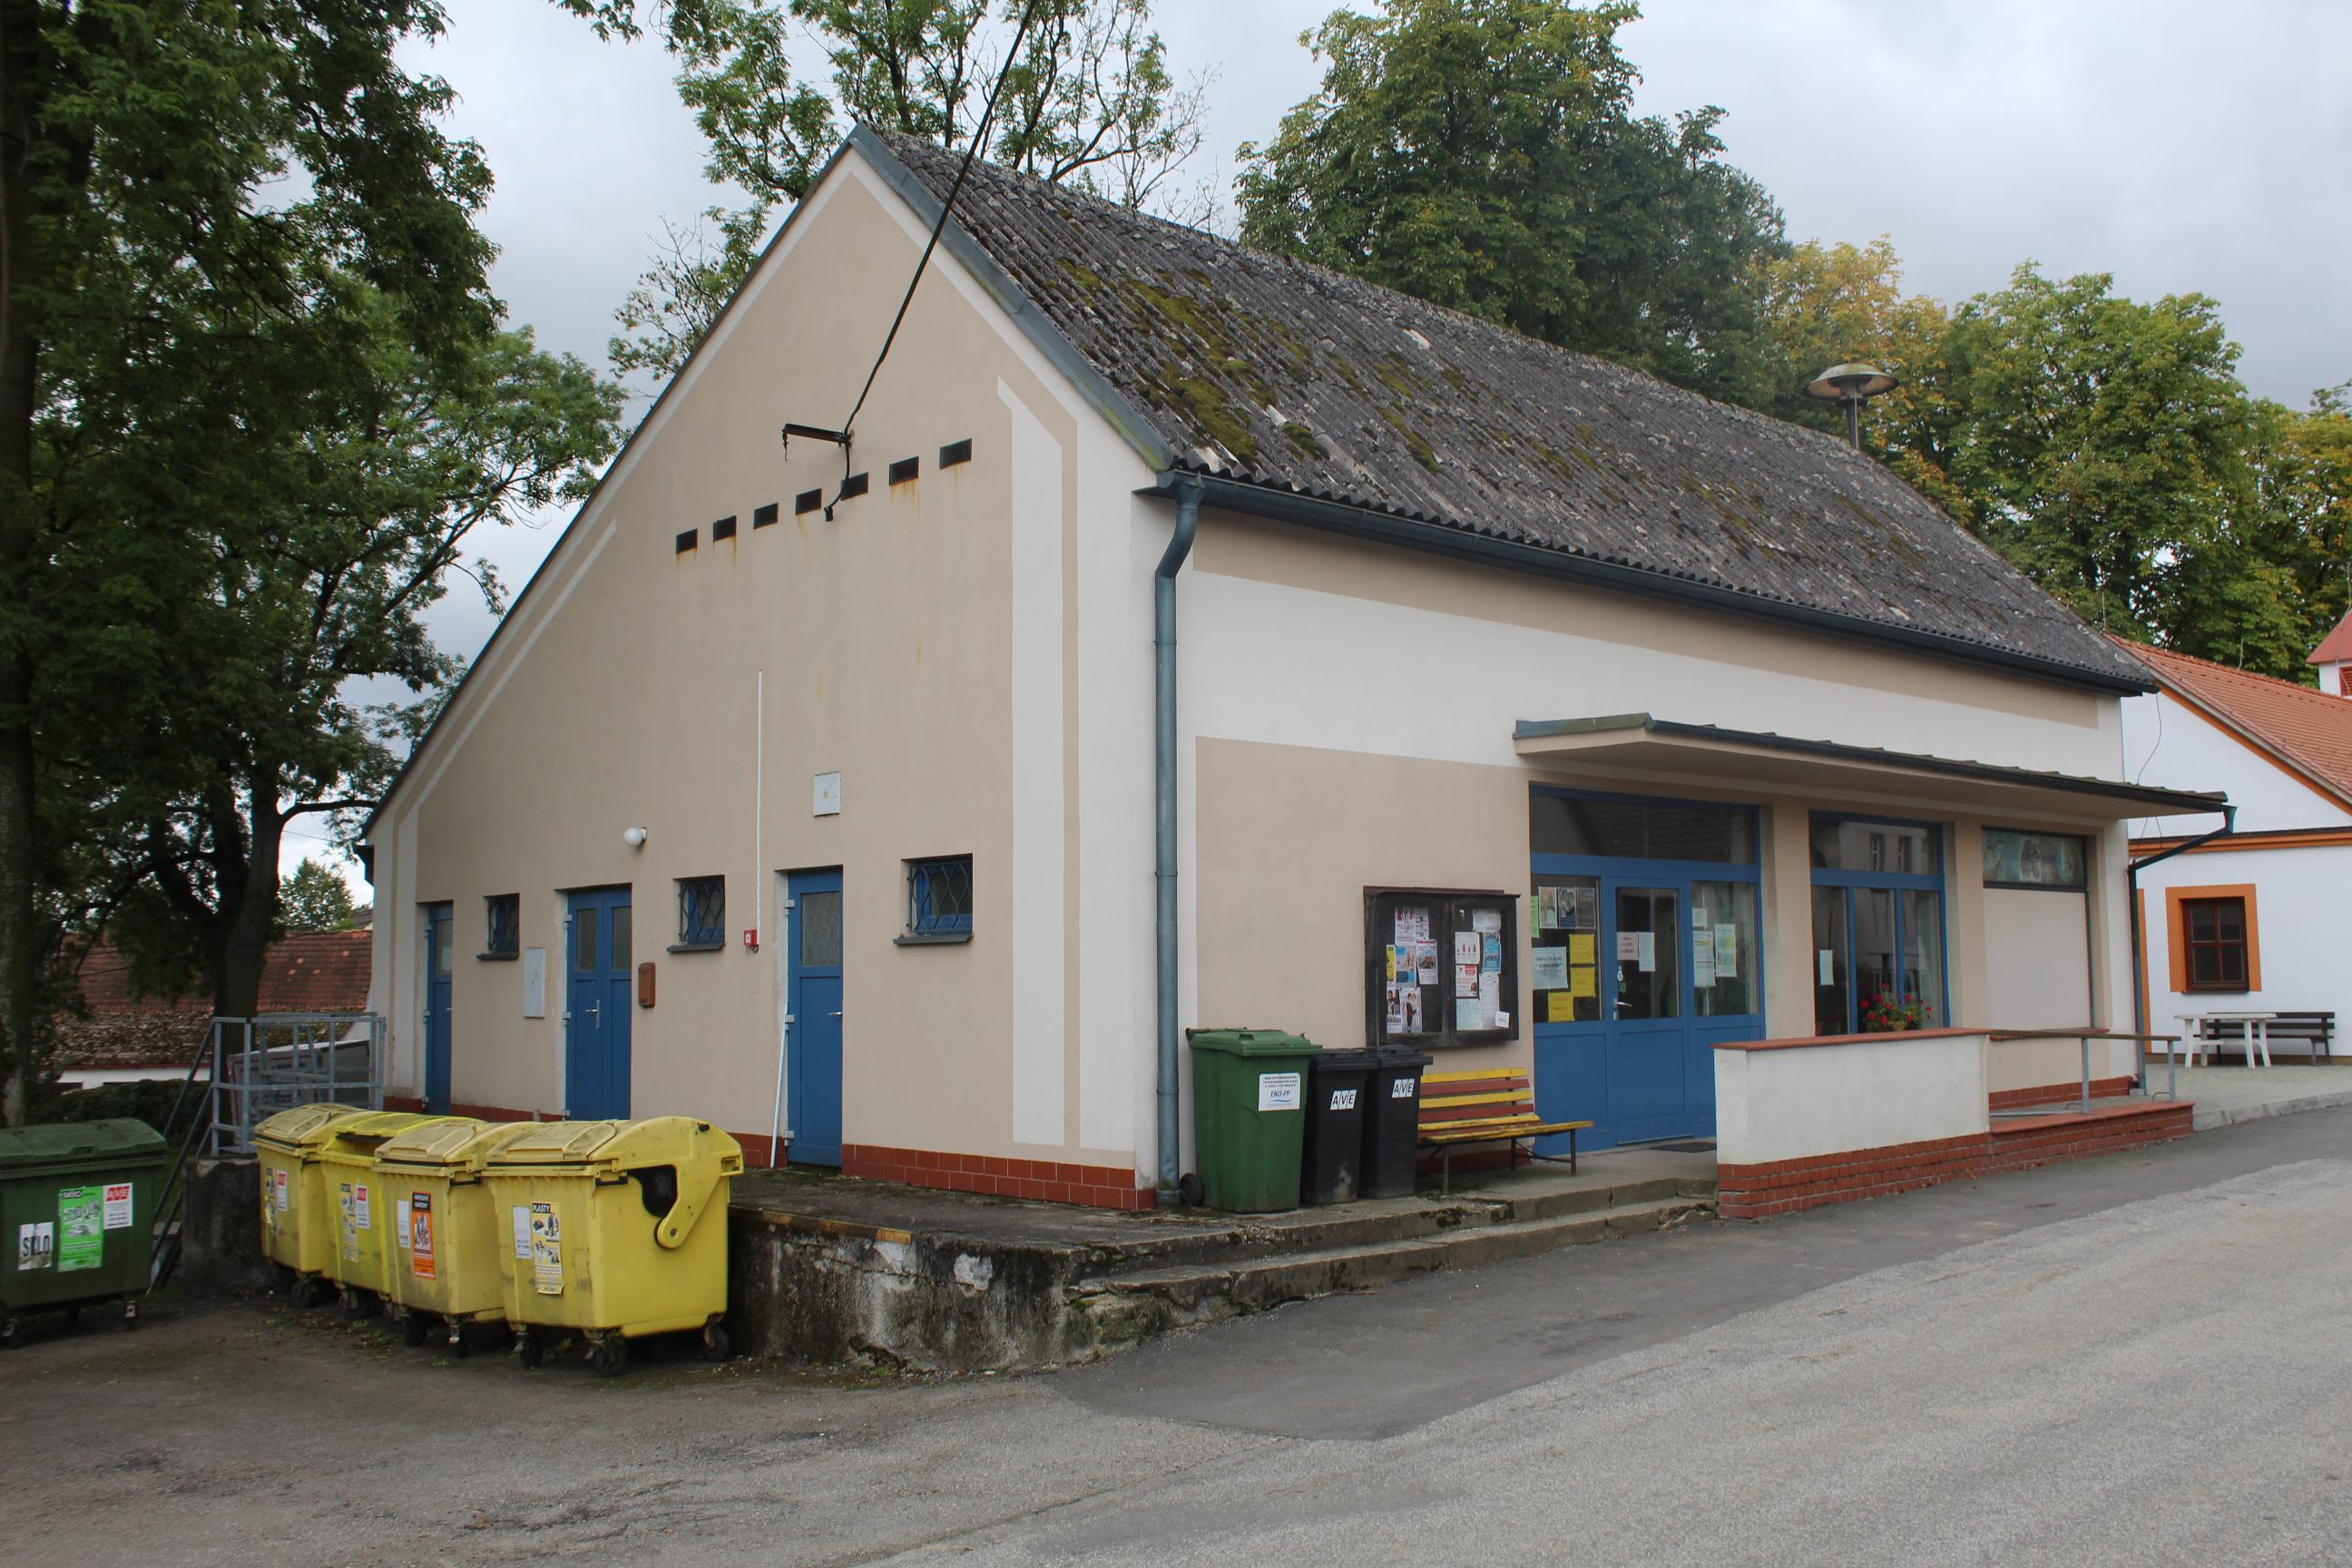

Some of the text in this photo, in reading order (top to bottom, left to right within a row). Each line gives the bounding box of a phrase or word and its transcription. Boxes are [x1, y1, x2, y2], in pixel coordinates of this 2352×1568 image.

[1270, 1090, 1291, 1098] EKO-PF
[1394, 1083, 1413, 1094] AVE
[1332, 1094, 1355, 1106] AVE
[106, 1185, 130, 1201] AVE
[532, 1204, 550, 1212] PLASTY
[23, 1234, 51, 1258] SKLO
